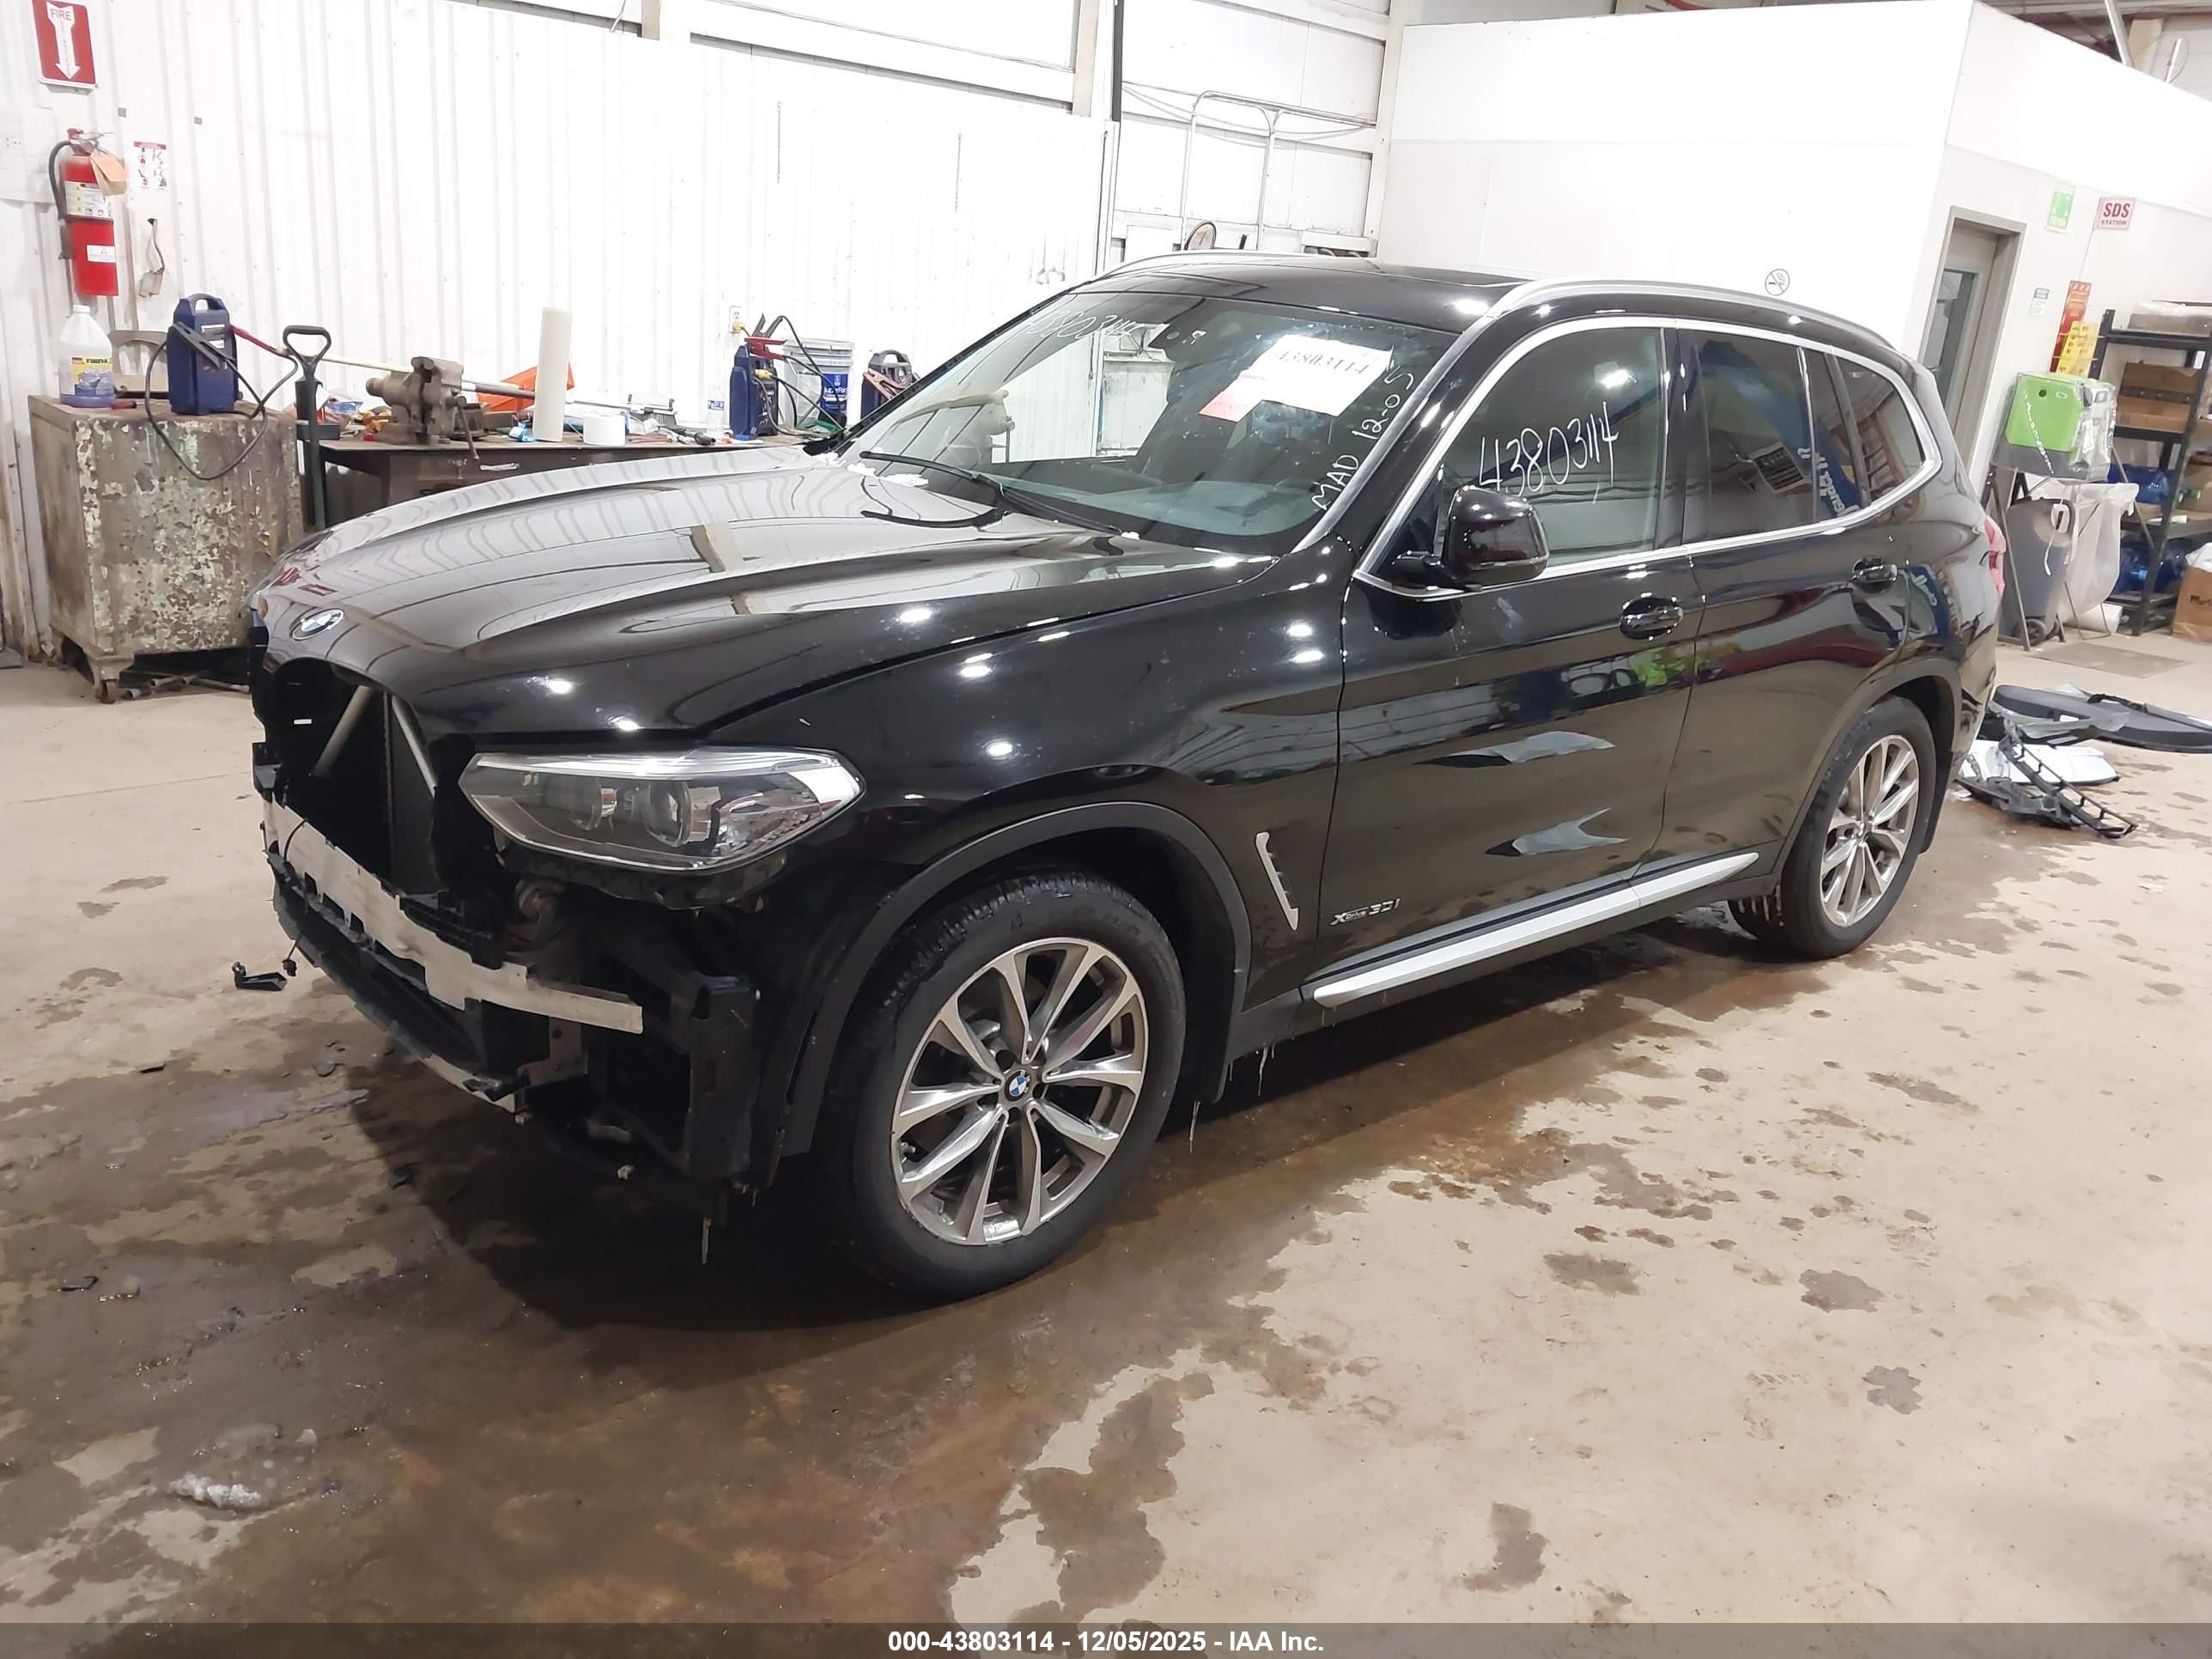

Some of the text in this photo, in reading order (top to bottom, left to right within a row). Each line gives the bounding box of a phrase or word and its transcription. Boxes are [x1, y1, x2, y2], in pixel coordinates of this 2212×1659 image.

[52, 9, 72, 21] FIRE
[2103, 203, 2130, 217] SDS
[1311, 454, 1359, 510] MAD
[1352, 364, 1414, 440] 12-05
[1480, 401, 1620, 498] 43803114
